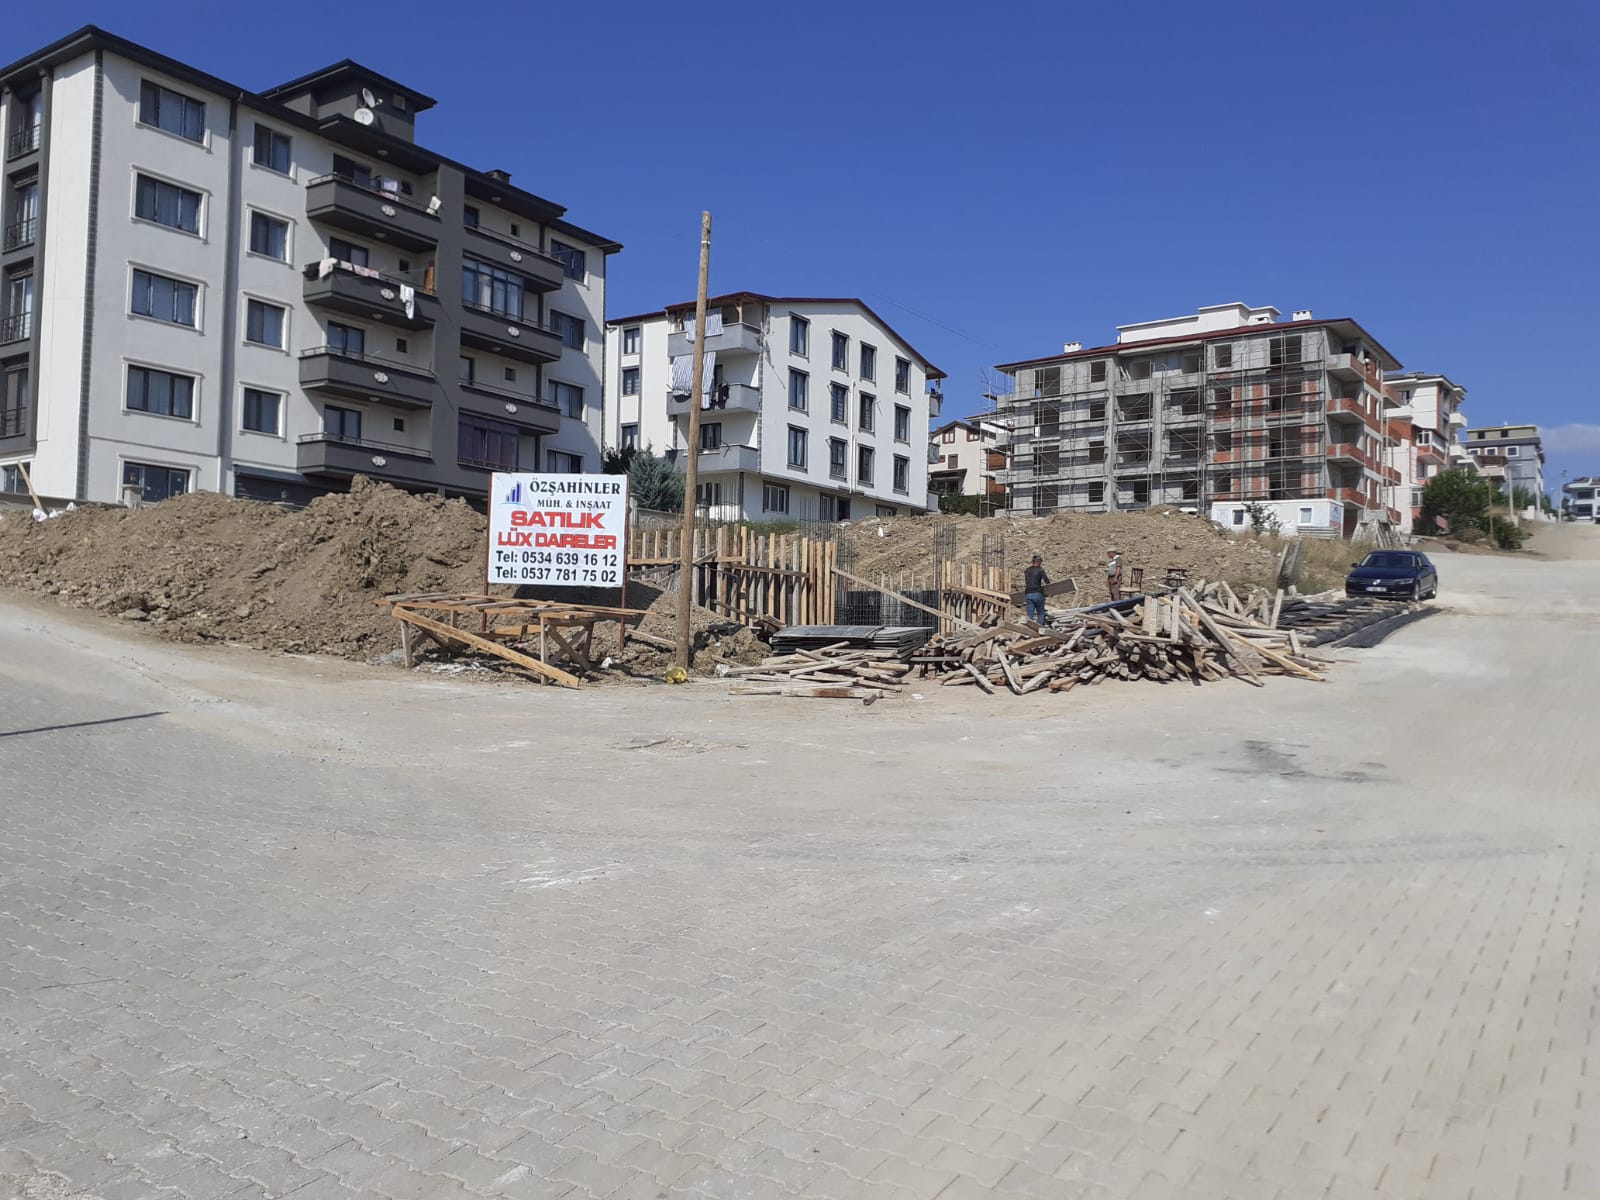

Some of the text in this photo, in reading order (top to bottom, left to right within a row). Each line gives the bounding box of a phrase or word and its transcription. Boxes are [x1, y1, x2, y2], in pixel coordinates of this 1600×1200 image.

[530, 477, 620, 496] ÖZŞAHİNLER
[566, 500, 573, 508] &
[511, 511, 605, 529] SATILIK
[498, 527, 533, 546] LÜX
[496, 551, 617, 566] Tel: 0534 639 16 12
[495, 566, 617, 582] Tel: 0537 781 75 02
